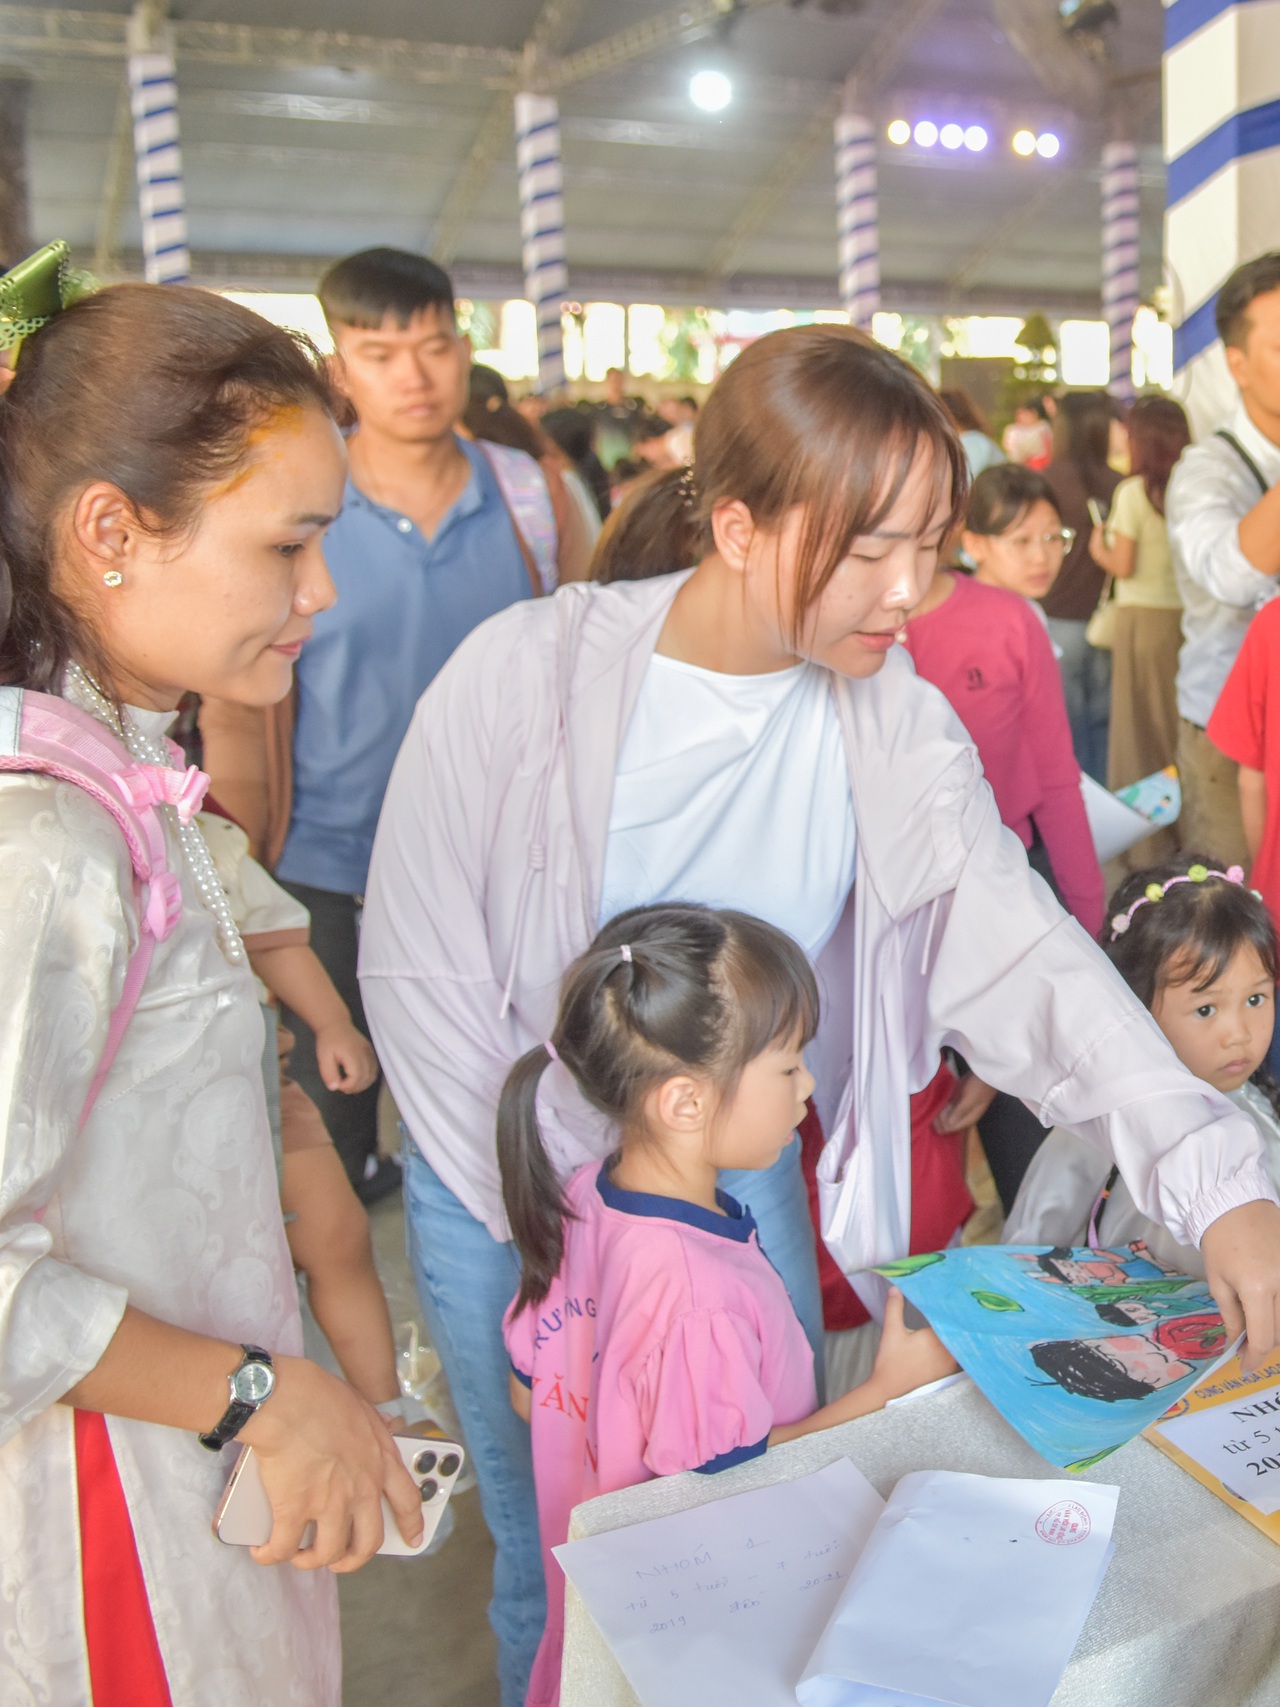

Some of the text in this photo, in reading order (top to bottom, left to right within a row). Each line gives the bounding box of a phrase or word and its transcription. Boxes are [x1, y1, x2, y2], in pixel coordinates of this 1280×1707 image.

[1194, 1384, 1224, 1399] CUNG
[1219, 1378, 1244, 1391] VĂN
[1257, 1365, 1280, 1379] LAO
[1222, 1438, 1252, 1455] từ
[1253, 1430, 1271, 1444] 5
[635, 1543, 712, 1580] NHÓM
[649, 1615, 687, 1633] 2019
